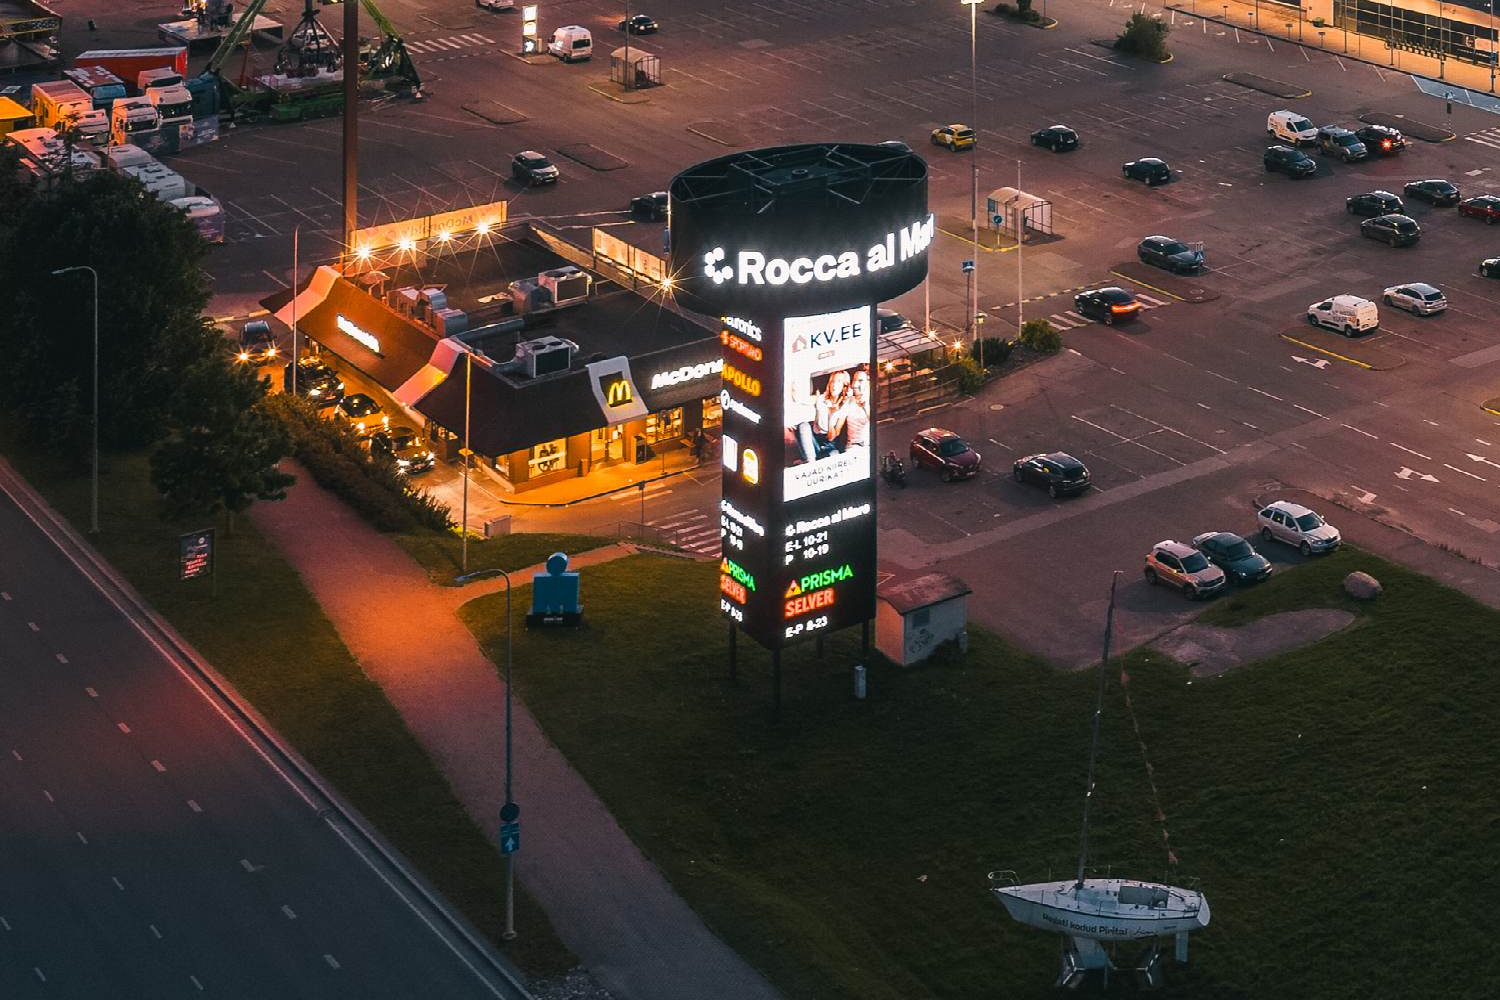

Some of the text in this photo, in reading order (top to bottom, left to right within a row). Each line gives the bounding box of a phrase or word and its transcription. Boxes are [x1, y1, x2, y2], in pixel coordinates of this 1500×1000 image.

[738, 251, 861, 285] Rocca
[867, 232, 895, 272] al
[810, 322, 863, 349] KV.EE
[721, 363, 761, 397] APOLLO
[728, 559, 756, 592] PRISMA
[801, 564, 854, 593] PRISMA
[785, 587, 835, 618] SELVER
